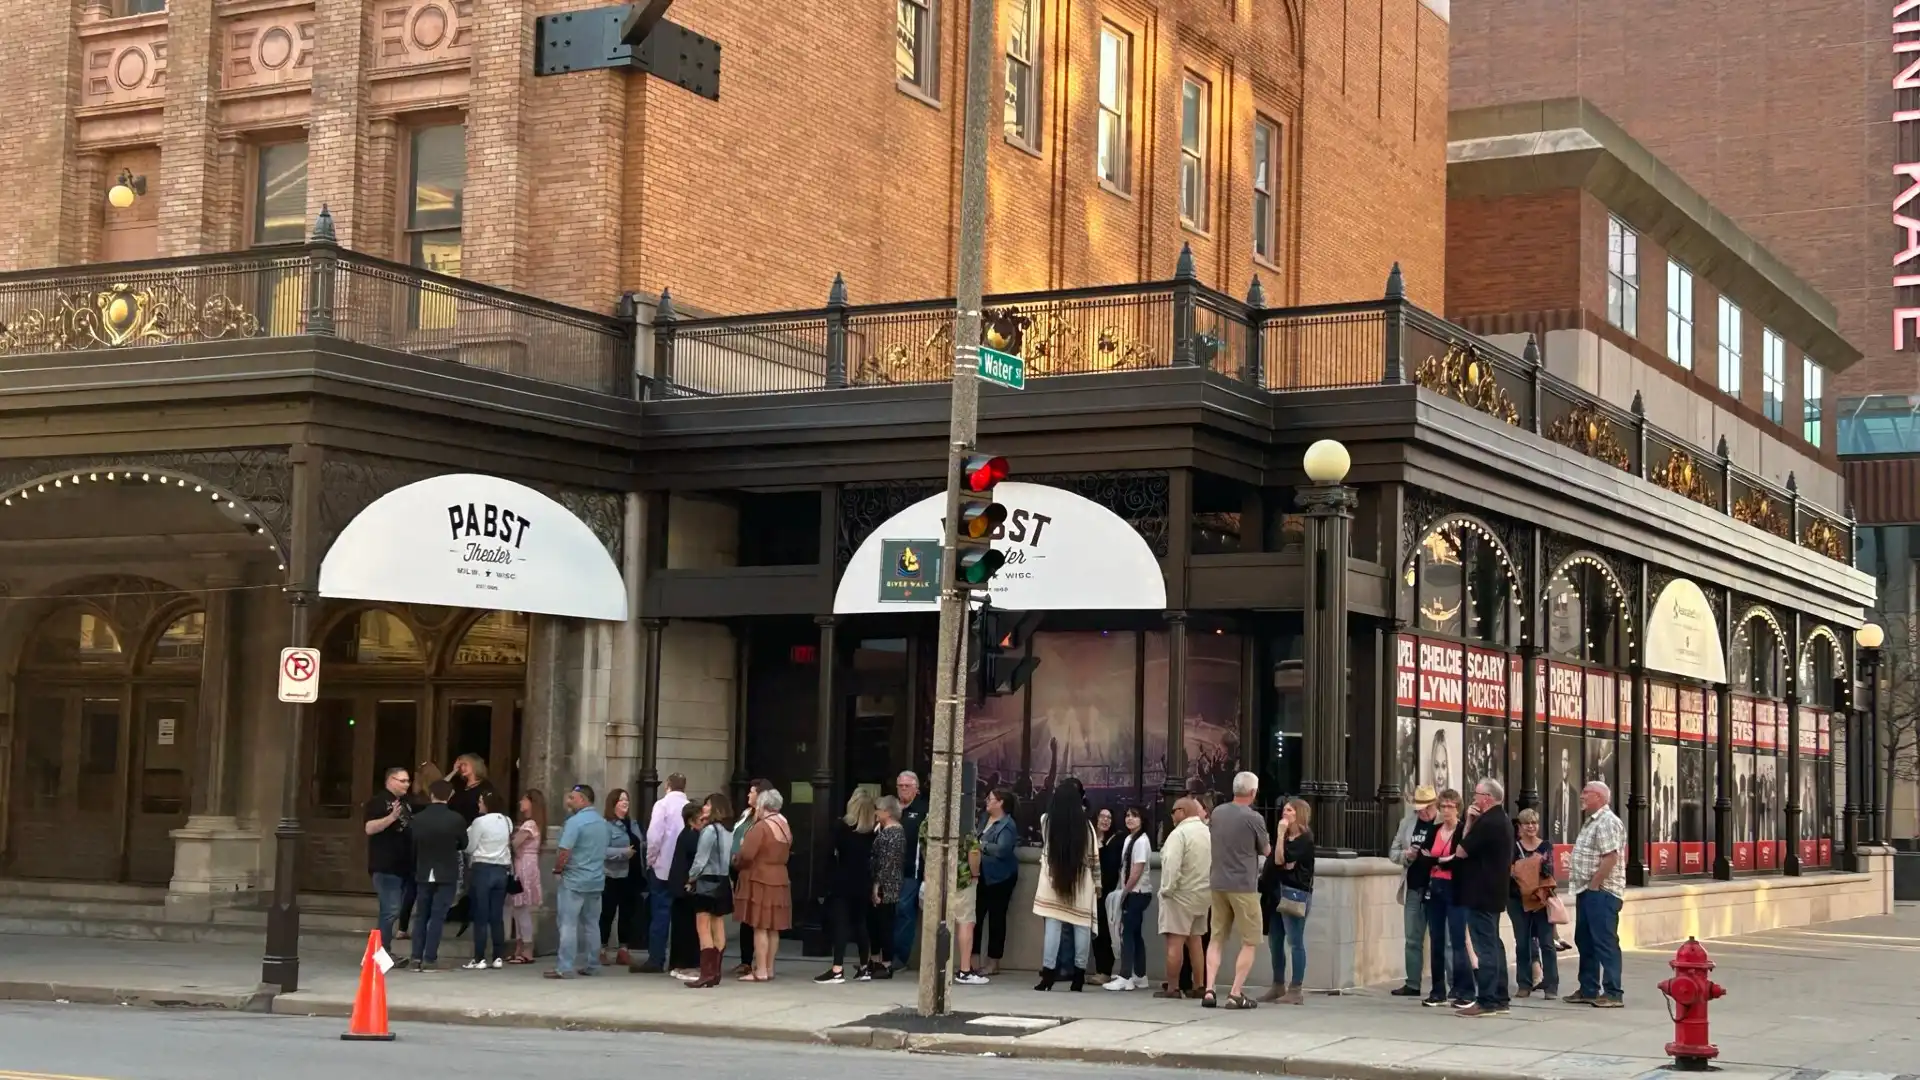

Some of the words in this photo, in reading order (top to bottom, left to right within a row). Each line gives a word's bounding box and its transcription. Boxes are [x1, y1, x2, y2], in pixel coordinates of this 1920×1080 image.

[984, 352, 1013, 381] Water
[448, 503, 531, 549] PABST
[463, 543, 512, 565] Theater
[886, 580, 908, 588] RIVER
[910, 580, 931, 588] WALK
[1421, 643, 1463, 675] CHELCIE
[1467, 652, 1505, 682] SCARY
[1420, 674, 1463, 705] LYNN
[1467, 681, 1506, 711] POCKETS
[1550, 667, 1583, 696] DREW
[1549, 691, 1583, 720] LYNCH
